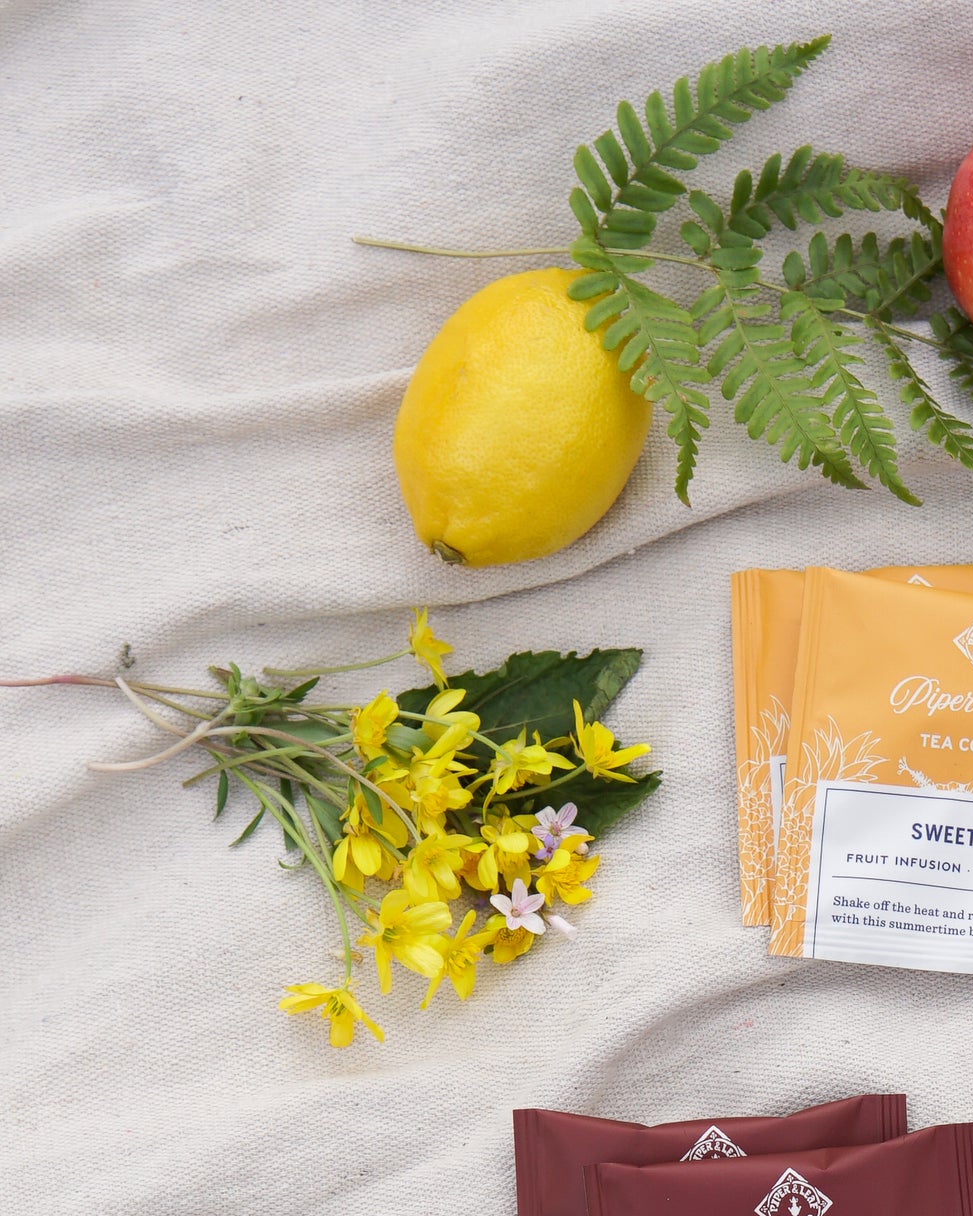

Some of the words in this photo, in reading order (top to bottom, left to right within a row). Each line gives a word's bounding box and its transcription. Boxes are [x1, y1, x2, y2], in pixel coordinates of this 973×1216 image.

[920, 733, 952, 750] TEA
[847, 853, 888, 864] FRUIT
[895, 856, 961, 873] INFUSION
[833, 896, 870, 909] Shake
[873, 900, 891, 911] off
[892, 902, 911, 913] the
[914, 904, 939, 917] heat
[942, 909, 964, 920] and
[832, 913, 859, 925] with
[863, 915, 886, 927] this
[889, 921, 966, 936] summertime
[769, 1186, 790, 1213] PIPER
[791, 1183, 799, 1194] &
